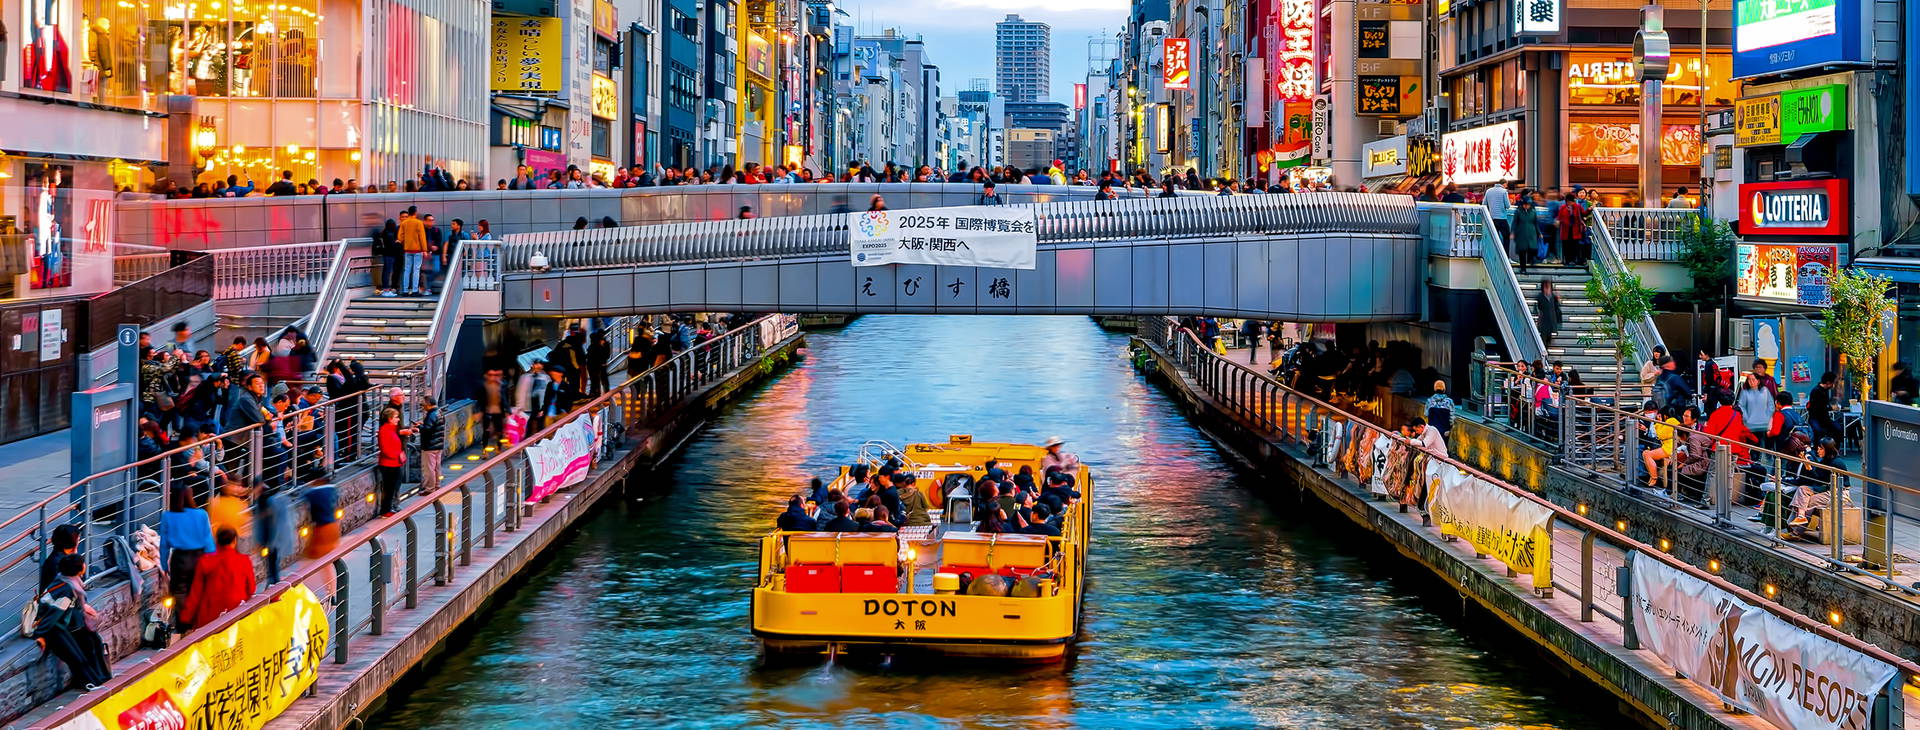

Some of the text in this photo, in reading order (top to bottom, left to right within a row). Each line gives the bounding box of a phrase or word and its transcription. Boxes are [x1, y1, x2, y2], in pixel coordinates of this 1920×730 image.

[1362, 39, 1386, 49] ドンキー
[1364, 31, 1384, 40] びっくり
[496, 21, 508, 83] あなたのお店づくり
[519, 19, 542, 90] 素晴らしい夢の実現
[1166, 45, 1176, 77] ドラッグ
[1176, 41, 1187, 70] ツルハ
[1364, 84, 1396, 98] びっくり
[1362, 98, 1398, 111] ドンキー
[1315, 112, 1323, 136] ZERO
[1765, 194, 1823, 222] LOTTERIA
[899, 215, 1034, 234] 2025年 国際博覧会を
[862, 277, 1010, 299] えびす橋
[1891, 426, 1919, 441] information
[864, 600, 956, 617] DOTON
[894, 619, 926, 631] 大阪
[1737, 636, 1787, 694] MGM
